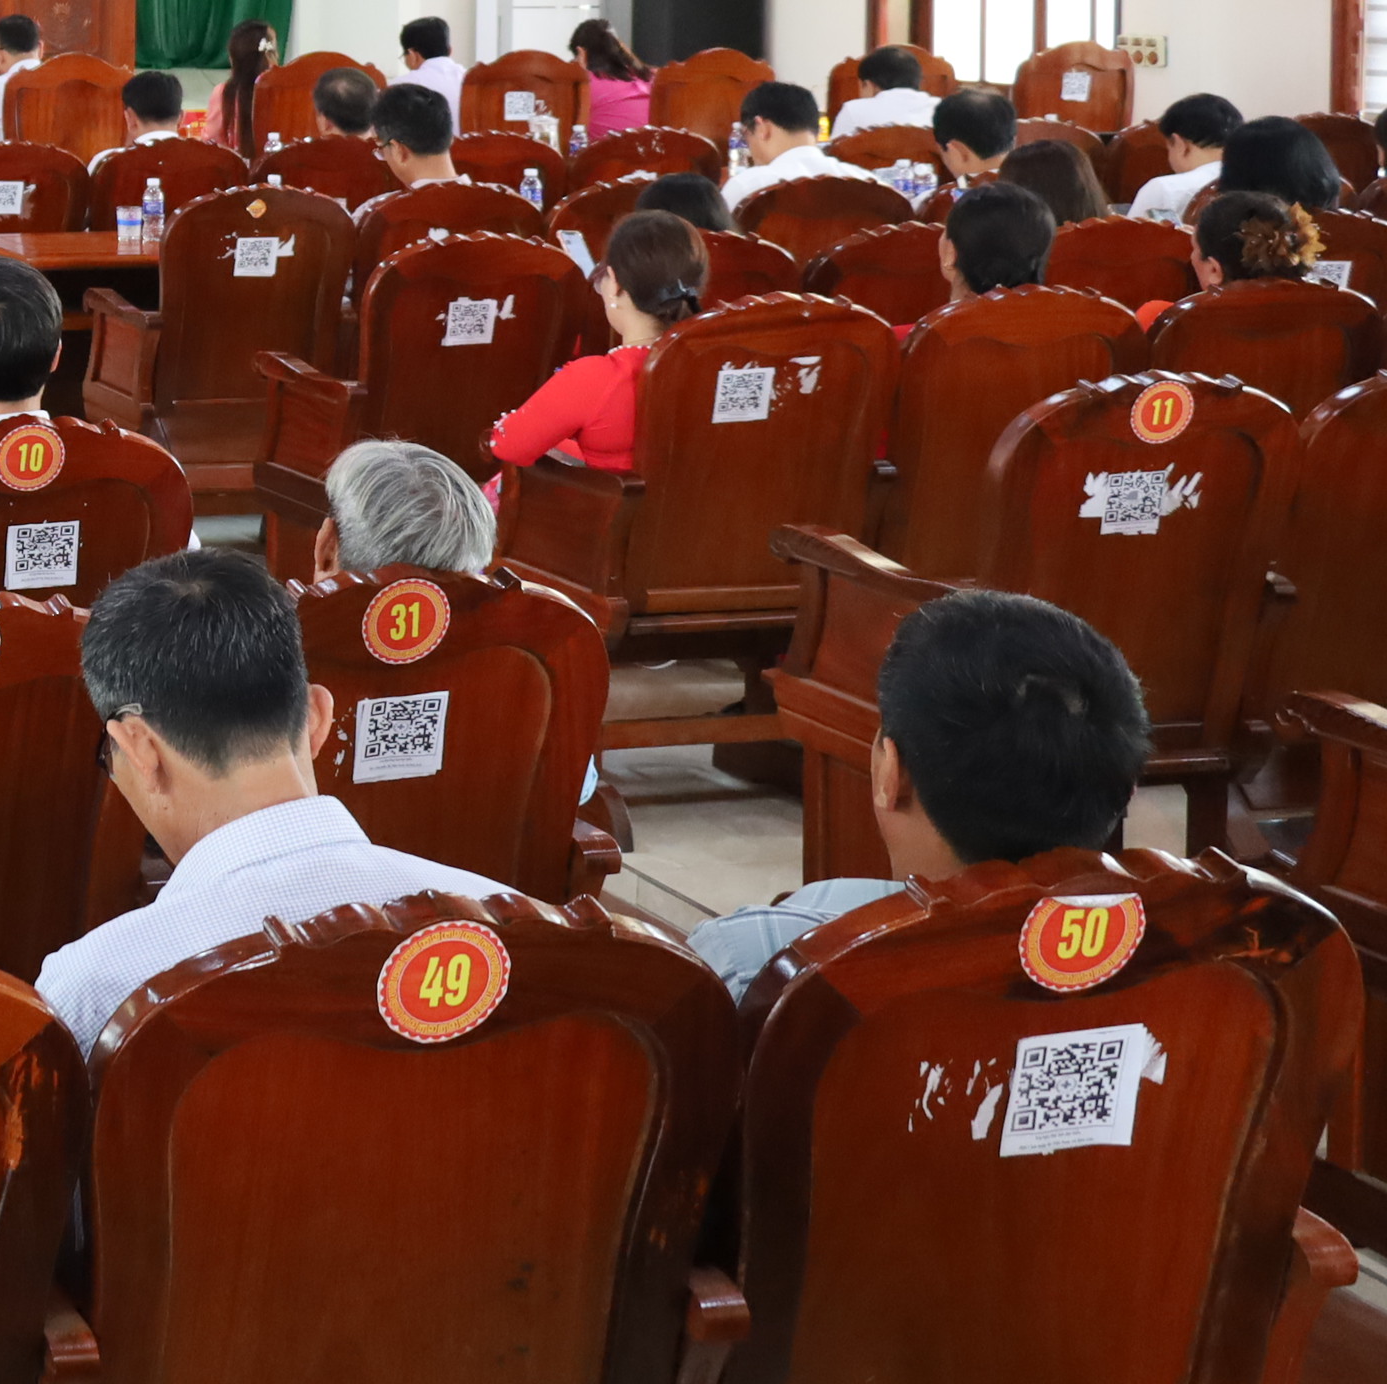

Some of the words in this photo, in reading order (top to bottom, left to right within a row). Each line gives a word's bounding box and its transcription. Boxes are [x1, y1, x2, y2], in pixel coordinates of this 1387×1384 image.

[1153, 399, 1174, 425] 11
[18, 443, 44, 472] 10
[390, 601, 420, 640] 31
[1057, 908, 1109, 960] 50
[419, 953, 472, 1008] 49
